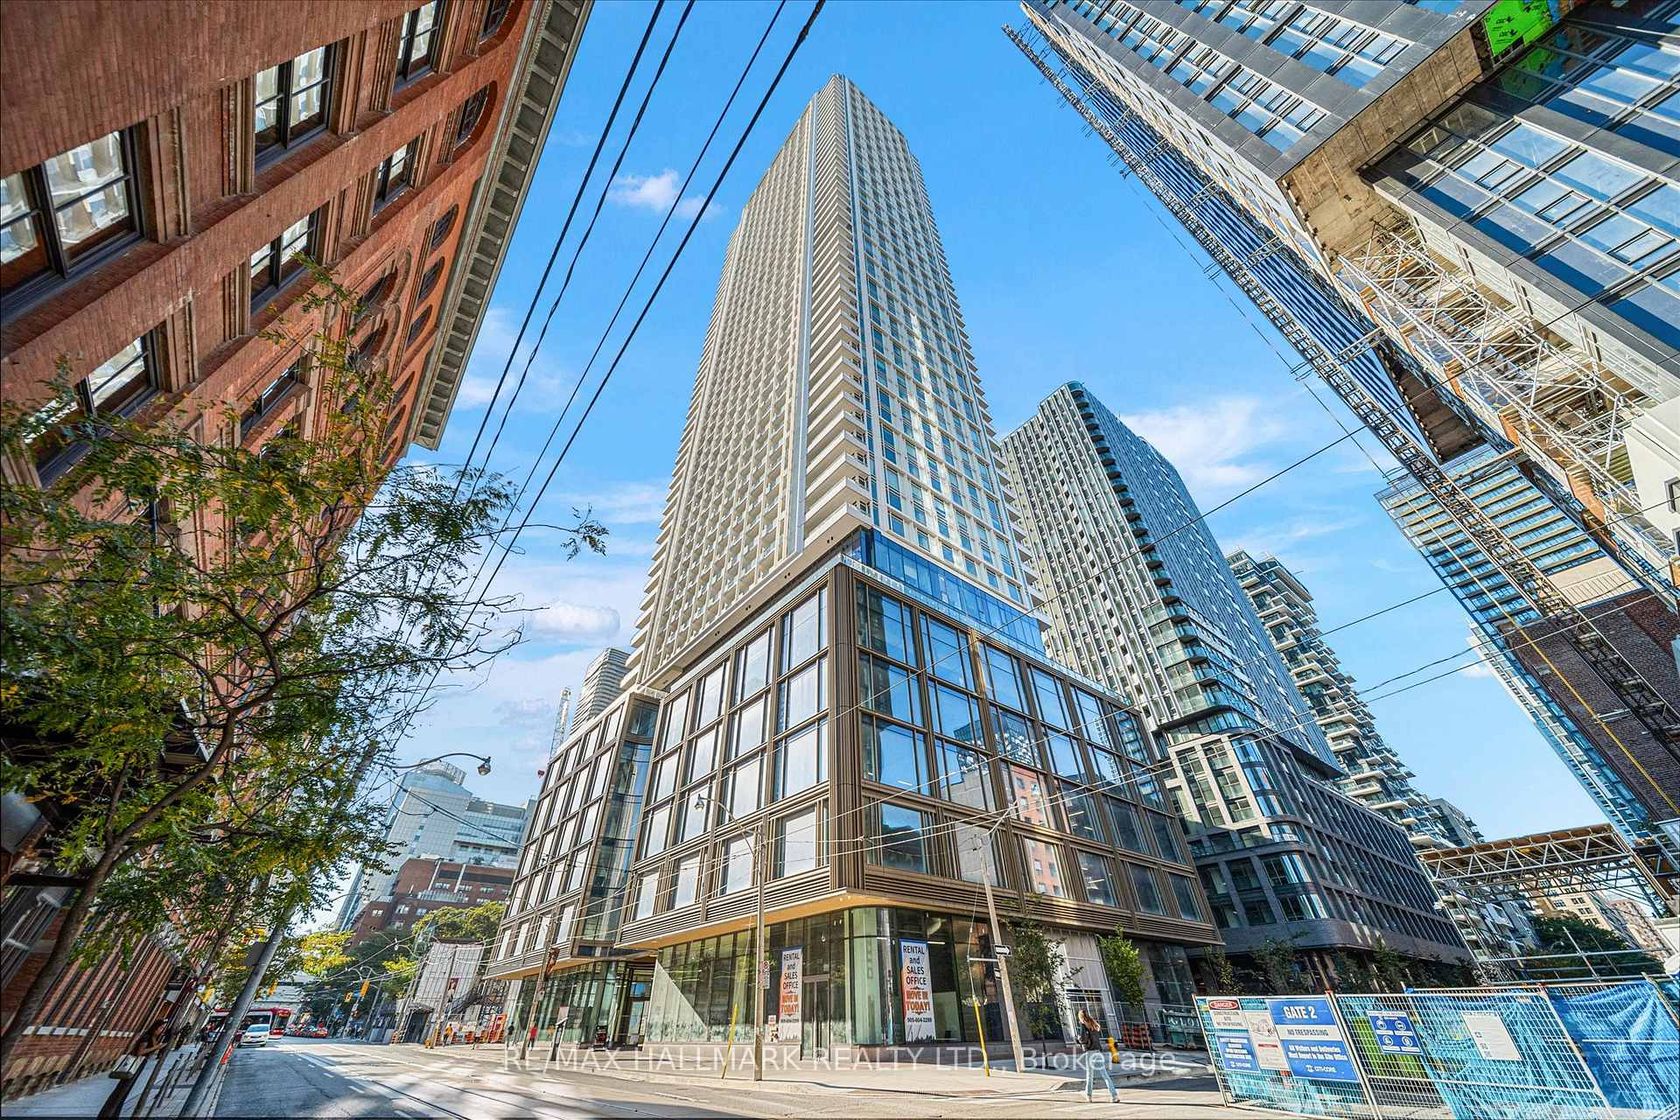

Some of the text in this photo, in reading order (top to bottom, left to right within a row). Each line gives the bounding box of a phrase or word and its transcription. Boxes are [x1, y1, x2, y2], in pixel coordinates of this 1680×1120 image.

[903, 945, 925, 955] RENTAL
[783, 953, 799, 961] RENTAL
[906, 966, 925, 975] SALES
[784, 972, 798, 980] SALES
[906, 977, 927, 985] OFFICE
[783, 982, 799, 990] OFFICE
[782, 994, 794, 1003] MOVE
[906, 991, 928, 1000] MOVE IN
[781, 1004, 799, 1014] TODAY!
[906, 1001, 930, 1011] TODAY!
[1283, 1006, 1317, 1018] GATE 2
[1287, 1028, 1329, 1036] NO TRESPASSING
